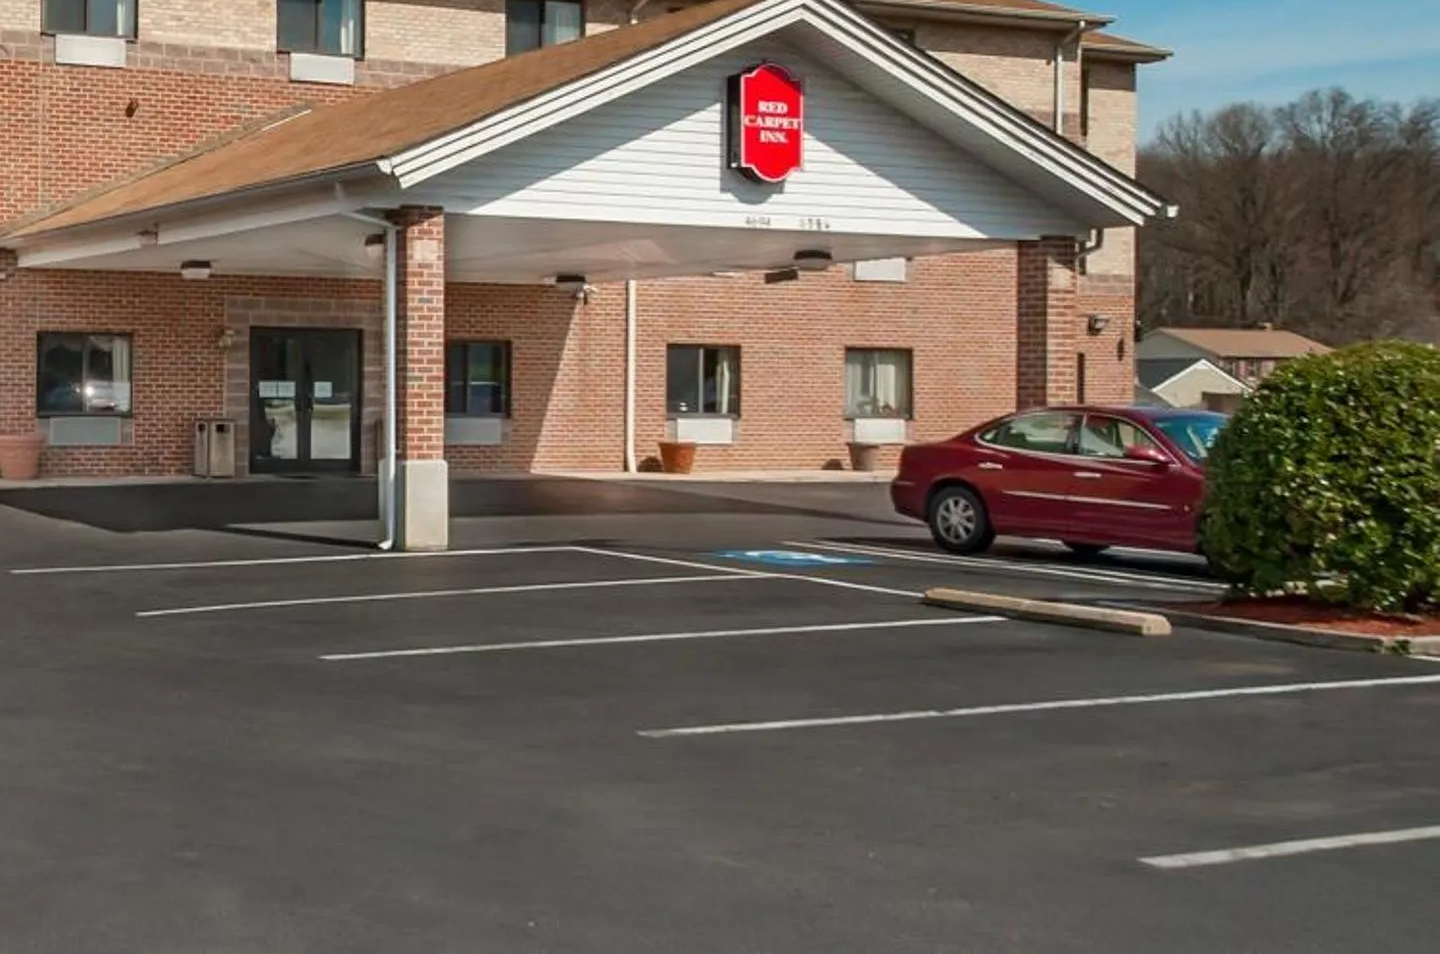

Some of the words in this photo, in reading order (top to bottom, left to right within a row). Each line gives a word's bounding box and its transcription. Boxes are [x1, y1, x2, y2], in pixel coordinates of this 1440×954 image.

[758, 101, 788, 114] RED
[744, 115, 800, 129] CARPET
[760, 131, 788, 143] INN
